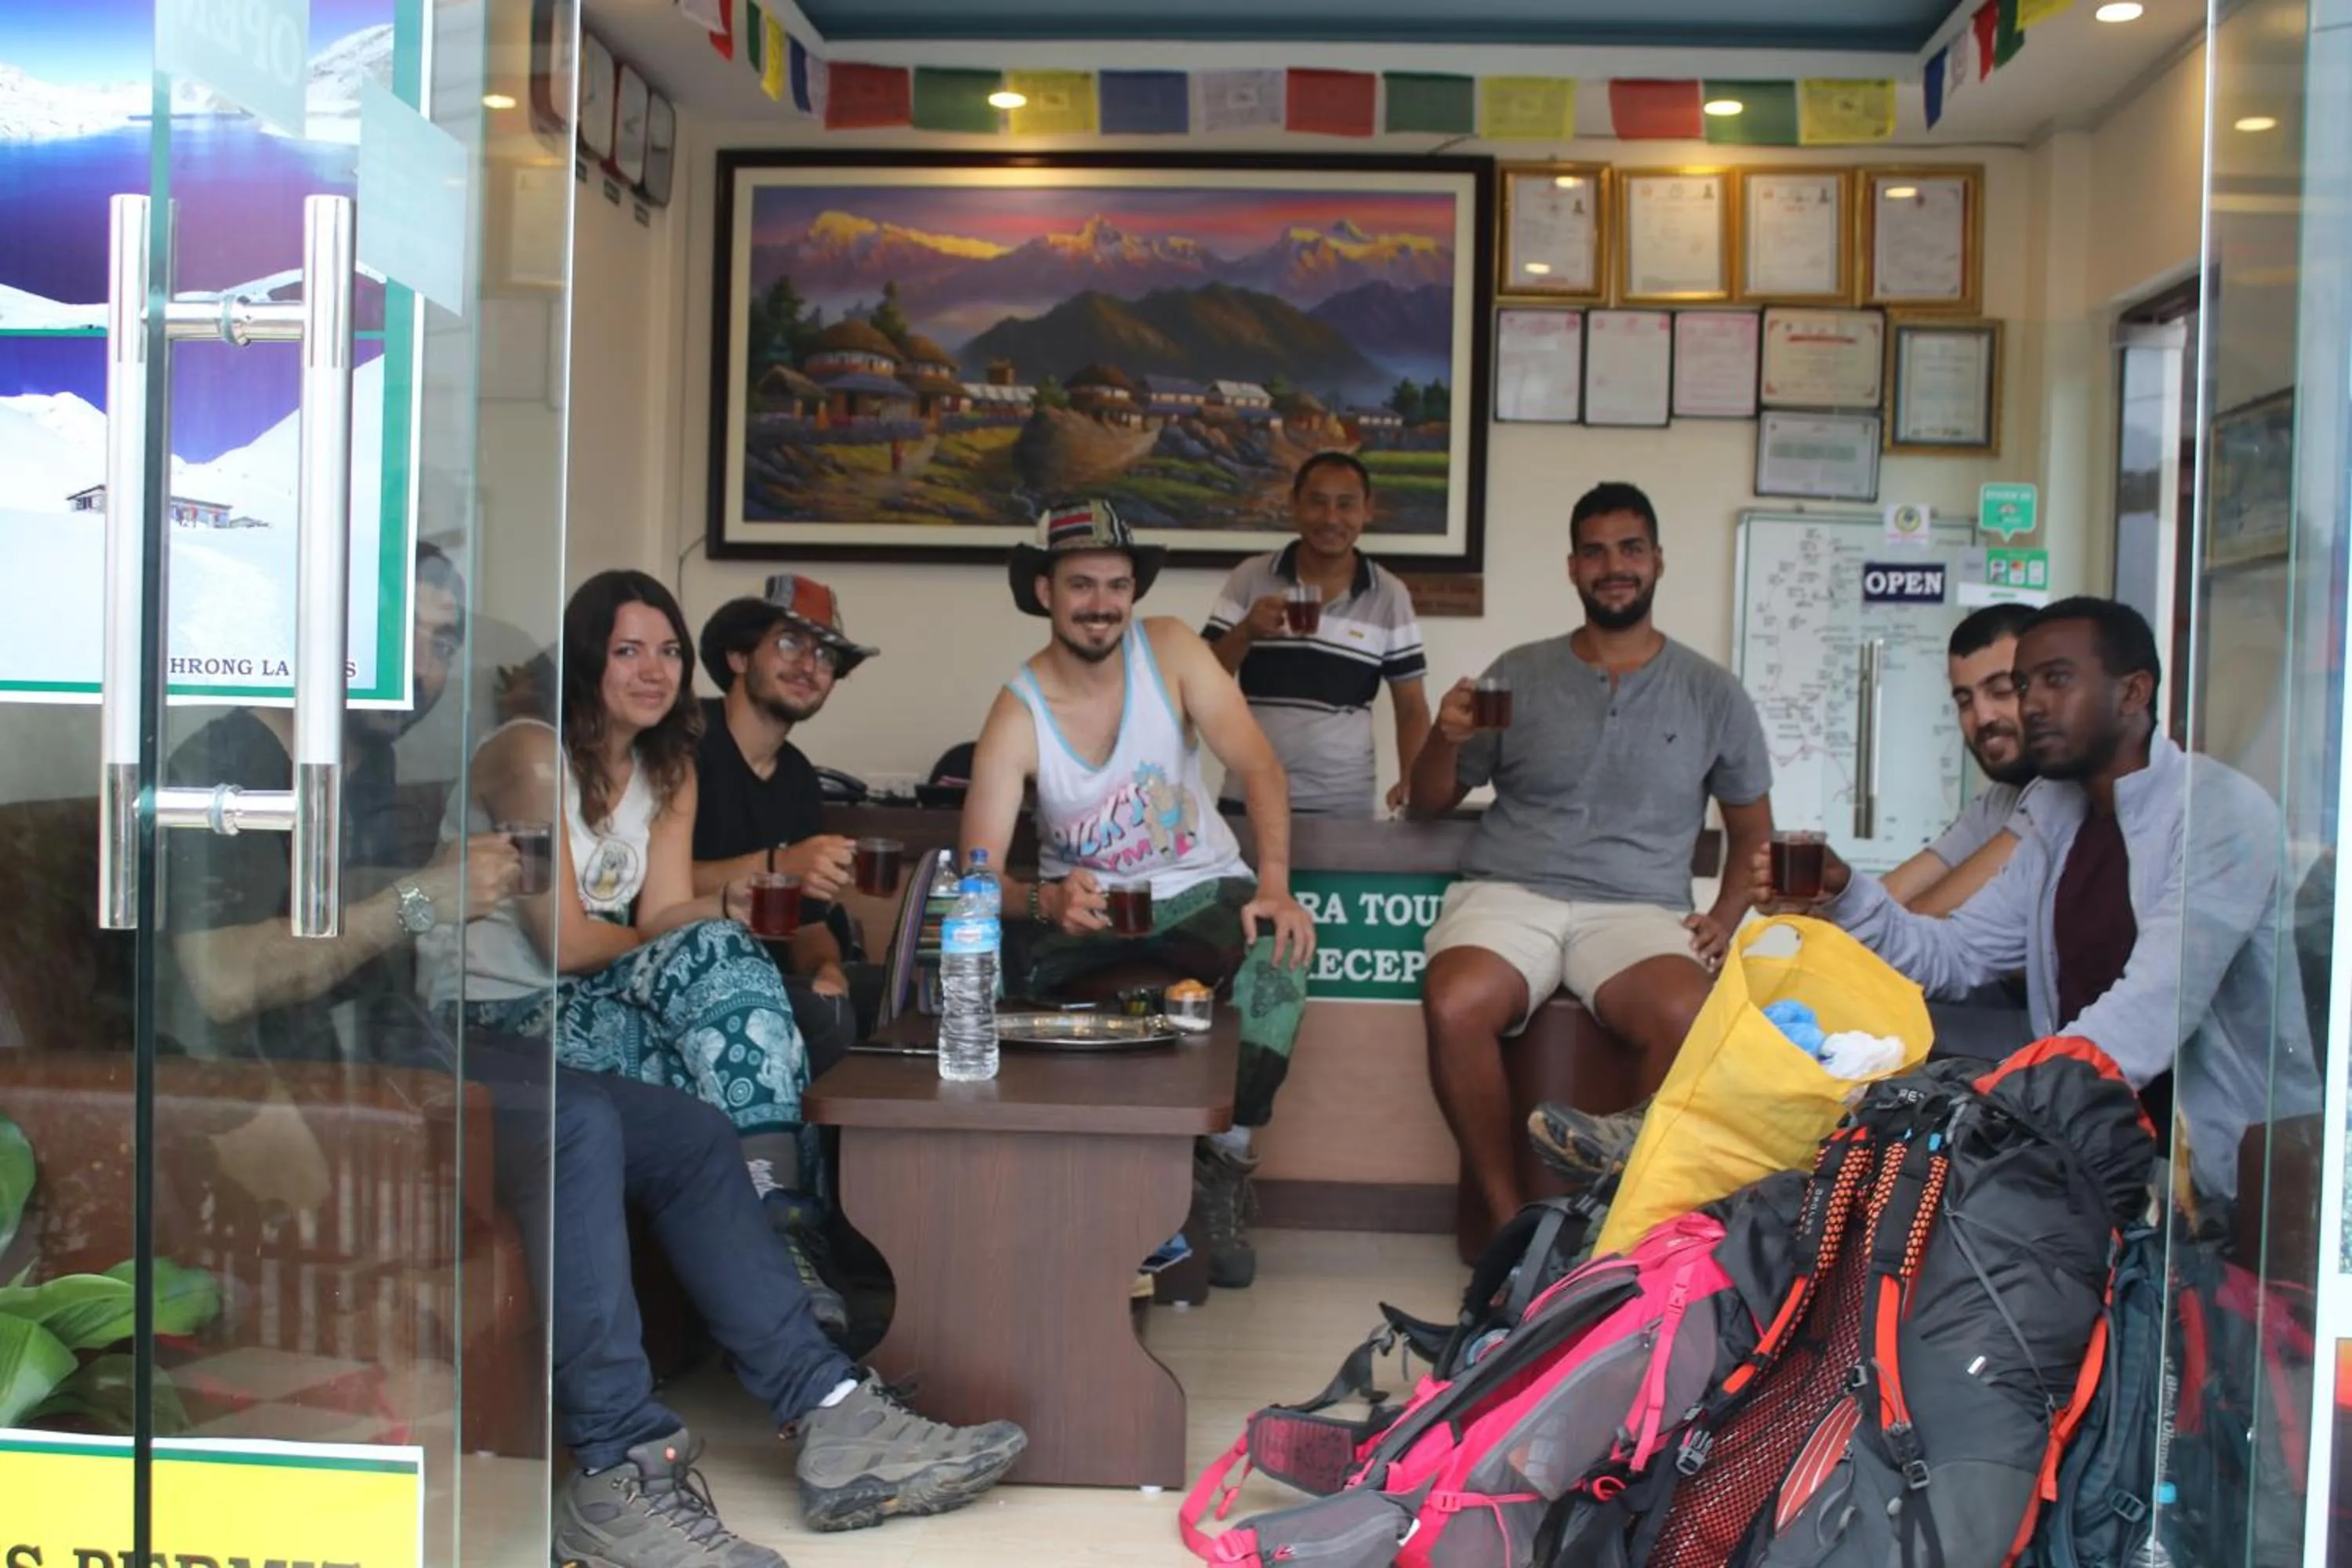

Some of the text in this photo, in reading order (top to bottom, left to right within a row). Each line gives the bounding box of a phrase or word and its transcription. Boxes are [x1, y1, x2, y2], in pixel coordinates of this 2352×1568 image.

[1865, 571, 1943, 595] OPEN
[262, 659, 290, 677] LA
[1306, 947, 1427, 983] ECEP
